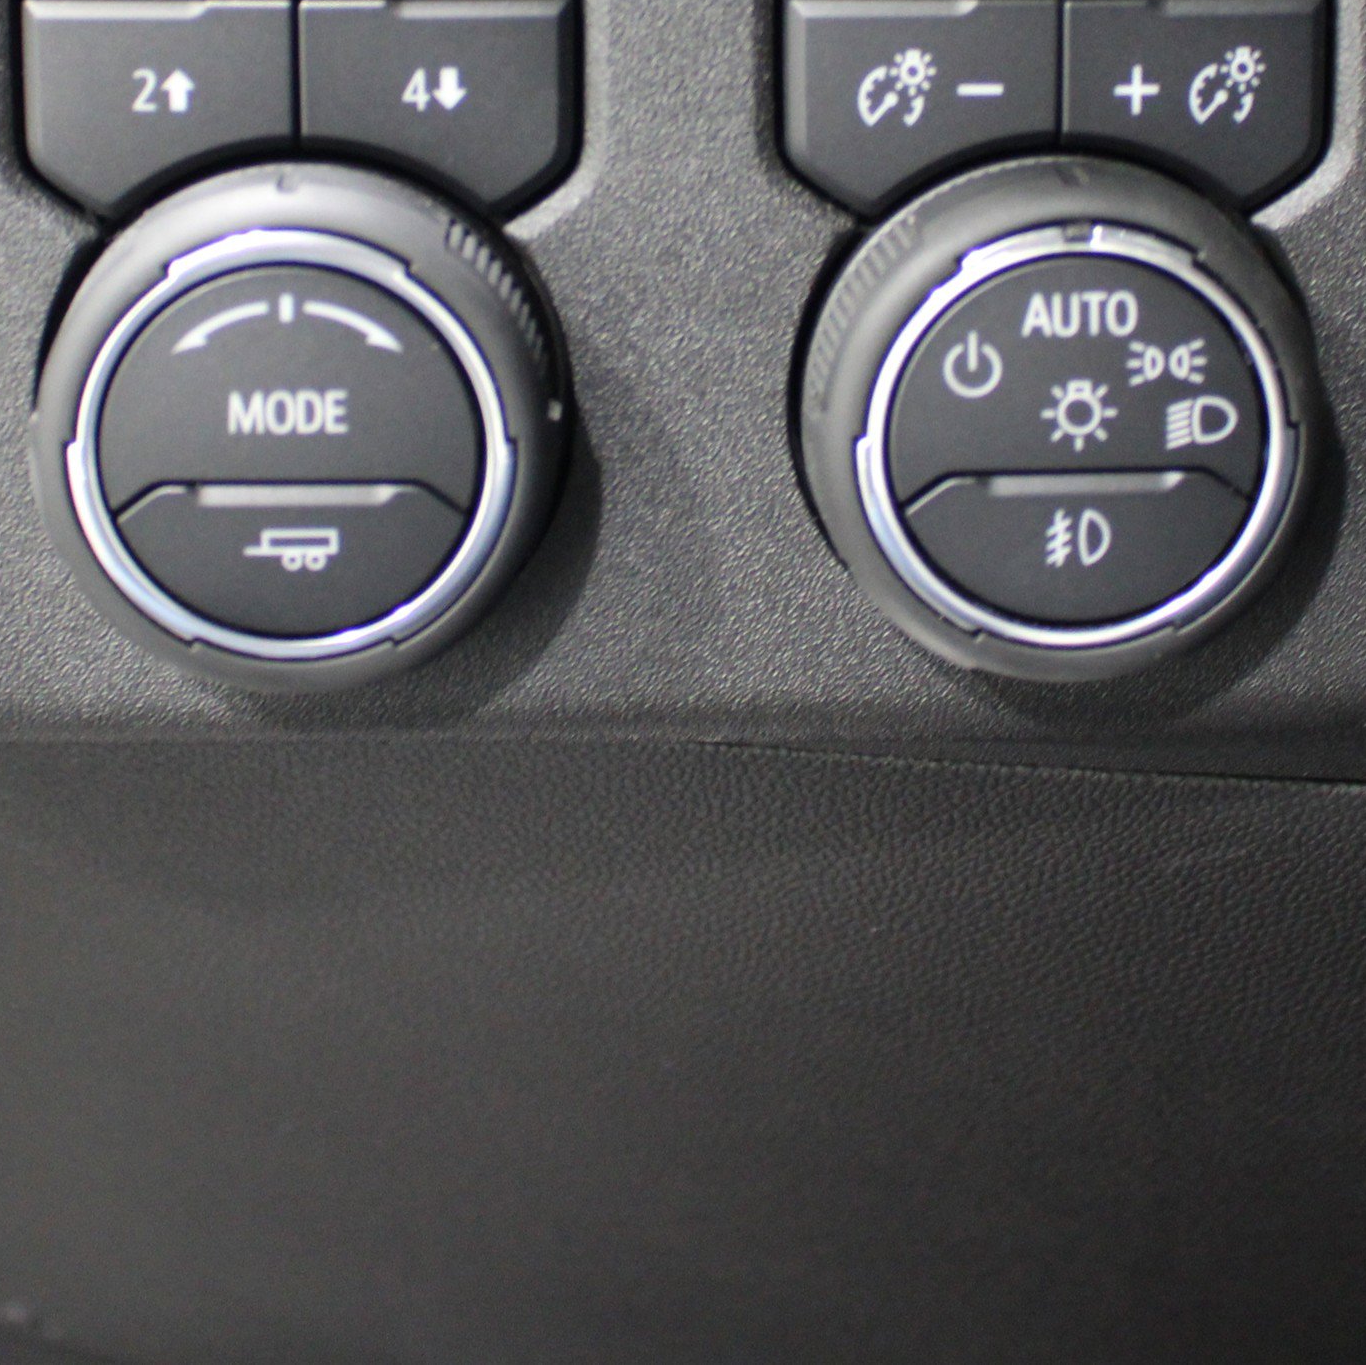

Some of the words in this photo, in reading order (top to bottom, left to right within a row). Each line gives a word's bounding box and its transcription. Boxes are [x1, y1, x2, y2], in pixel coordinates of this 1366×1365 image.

[131, 68, 158, 113] 2
[401, 67, 431, 112] 4
[1021, 290, 1139, 338] AUTO
[227, 389, 349, 436] MODE
